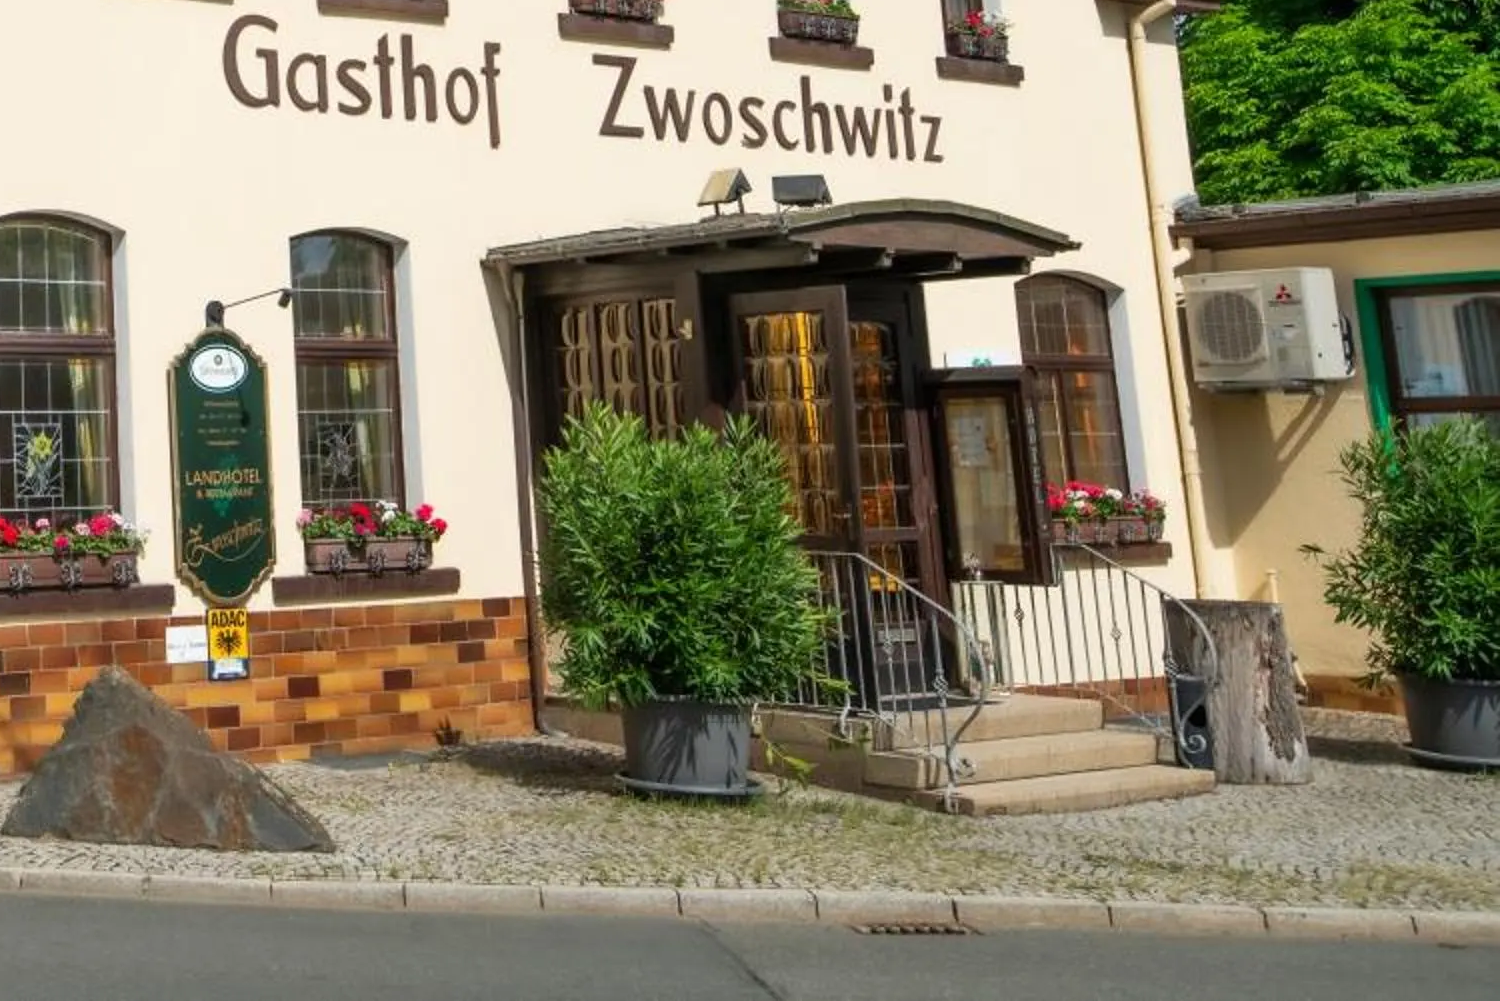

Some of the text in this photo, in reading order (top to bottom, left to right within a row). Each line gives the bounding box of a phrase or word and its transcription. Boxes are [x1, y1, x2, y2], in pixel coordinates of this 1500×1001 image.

[223, 14, 944, 163] Gasthof Zwoschwitz
[184, 467, 262, 486] LANDHOTEL
[211, 611, 245, 628] ADAC
